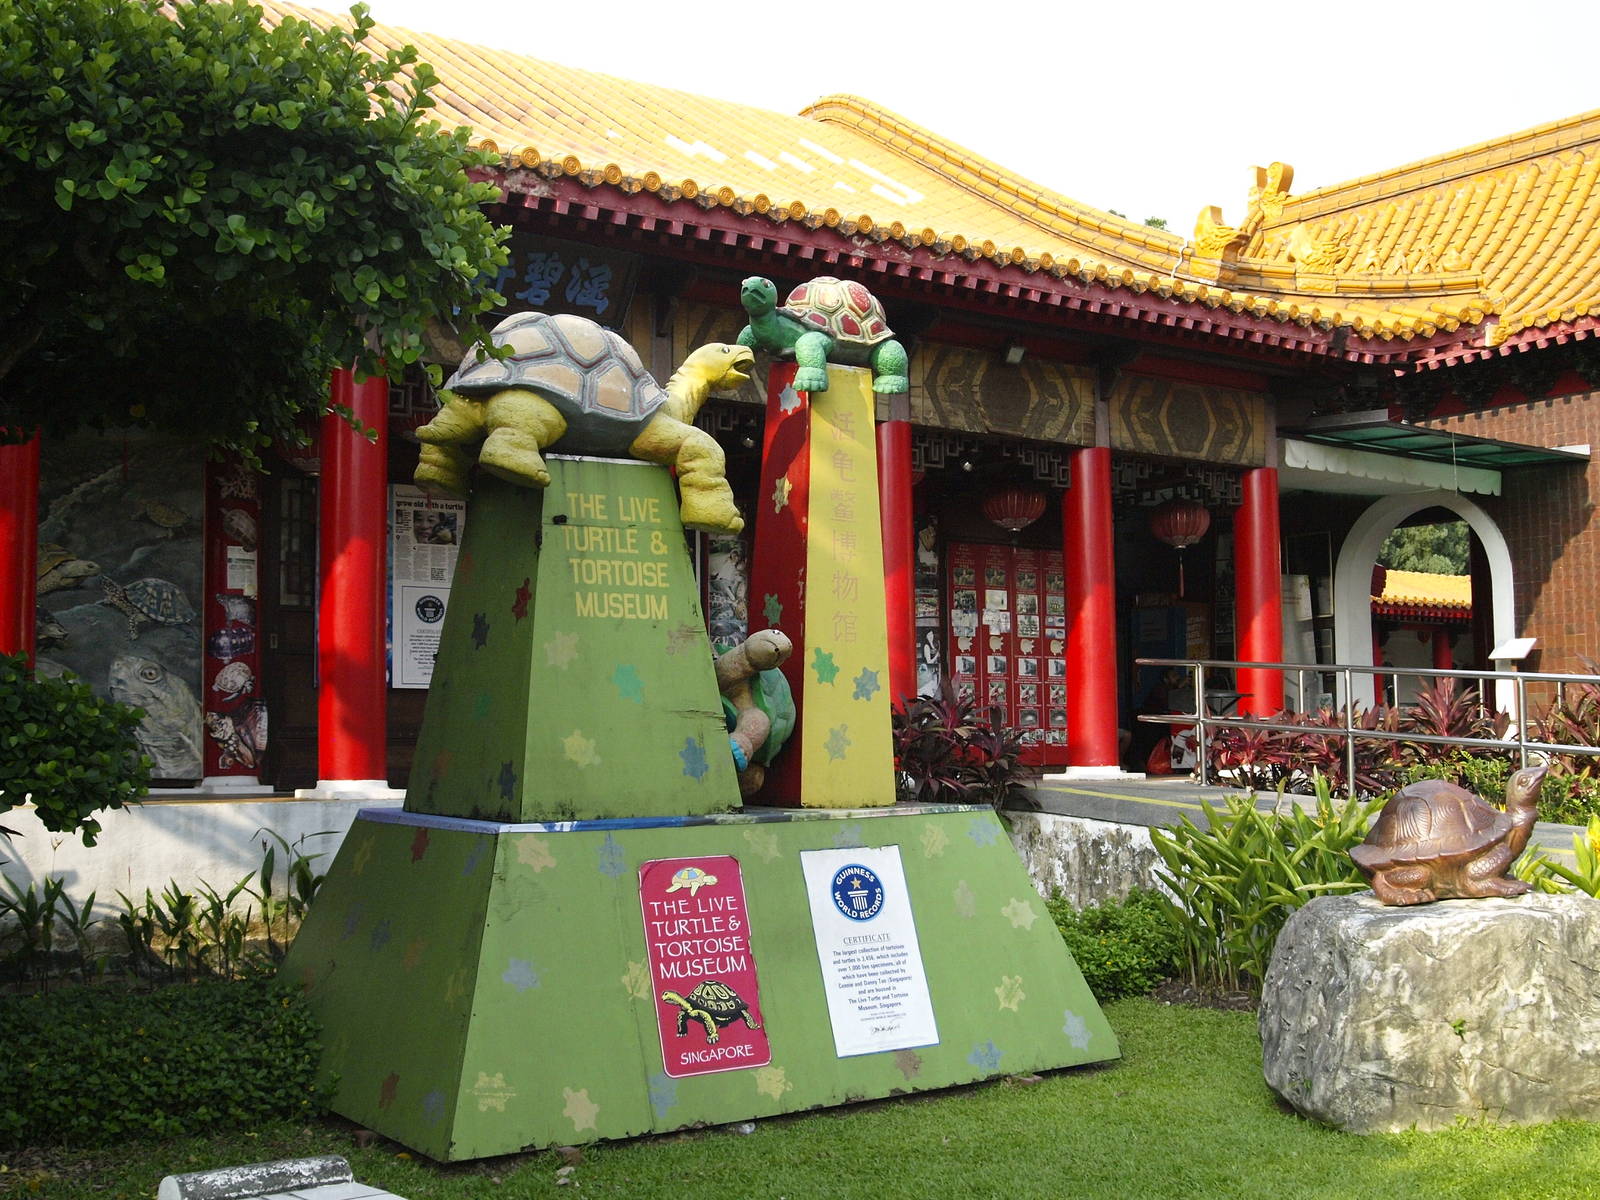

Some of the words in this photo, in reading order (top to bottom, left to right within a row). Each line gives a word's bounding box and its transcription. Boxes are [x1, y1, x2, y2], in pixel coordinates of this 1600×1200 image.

[446, 503, 464, 511] turtle
[566, 492, 608, 520] THE
[618, 496, 661, 523] LIVE
[560, 525, 639, 554] TURTLE
[651, 530, 668, 555] &
[569, 558, 670, 588] TORTOISE
[575, 591, 668, 620] MUSEUM
[836, 867, 875, 885] GUINNESS
[650, 899, 690, 916] THE
[697, 895, 738, 912] LIVE
[834, 891, 858, 918] WORLD
[860, 888, 882, 918] RECORDS
[652, 916, 724, 937] TURTLE
[728, 915, 741, 931] &
[655, 936, 745, 959] TORTOISE
[843, 933, 890, 944] CERTIFICATE
[659, 955, 747, 979] MUSEUM
[680, 1044, 755, 1065] SINGAPORE
